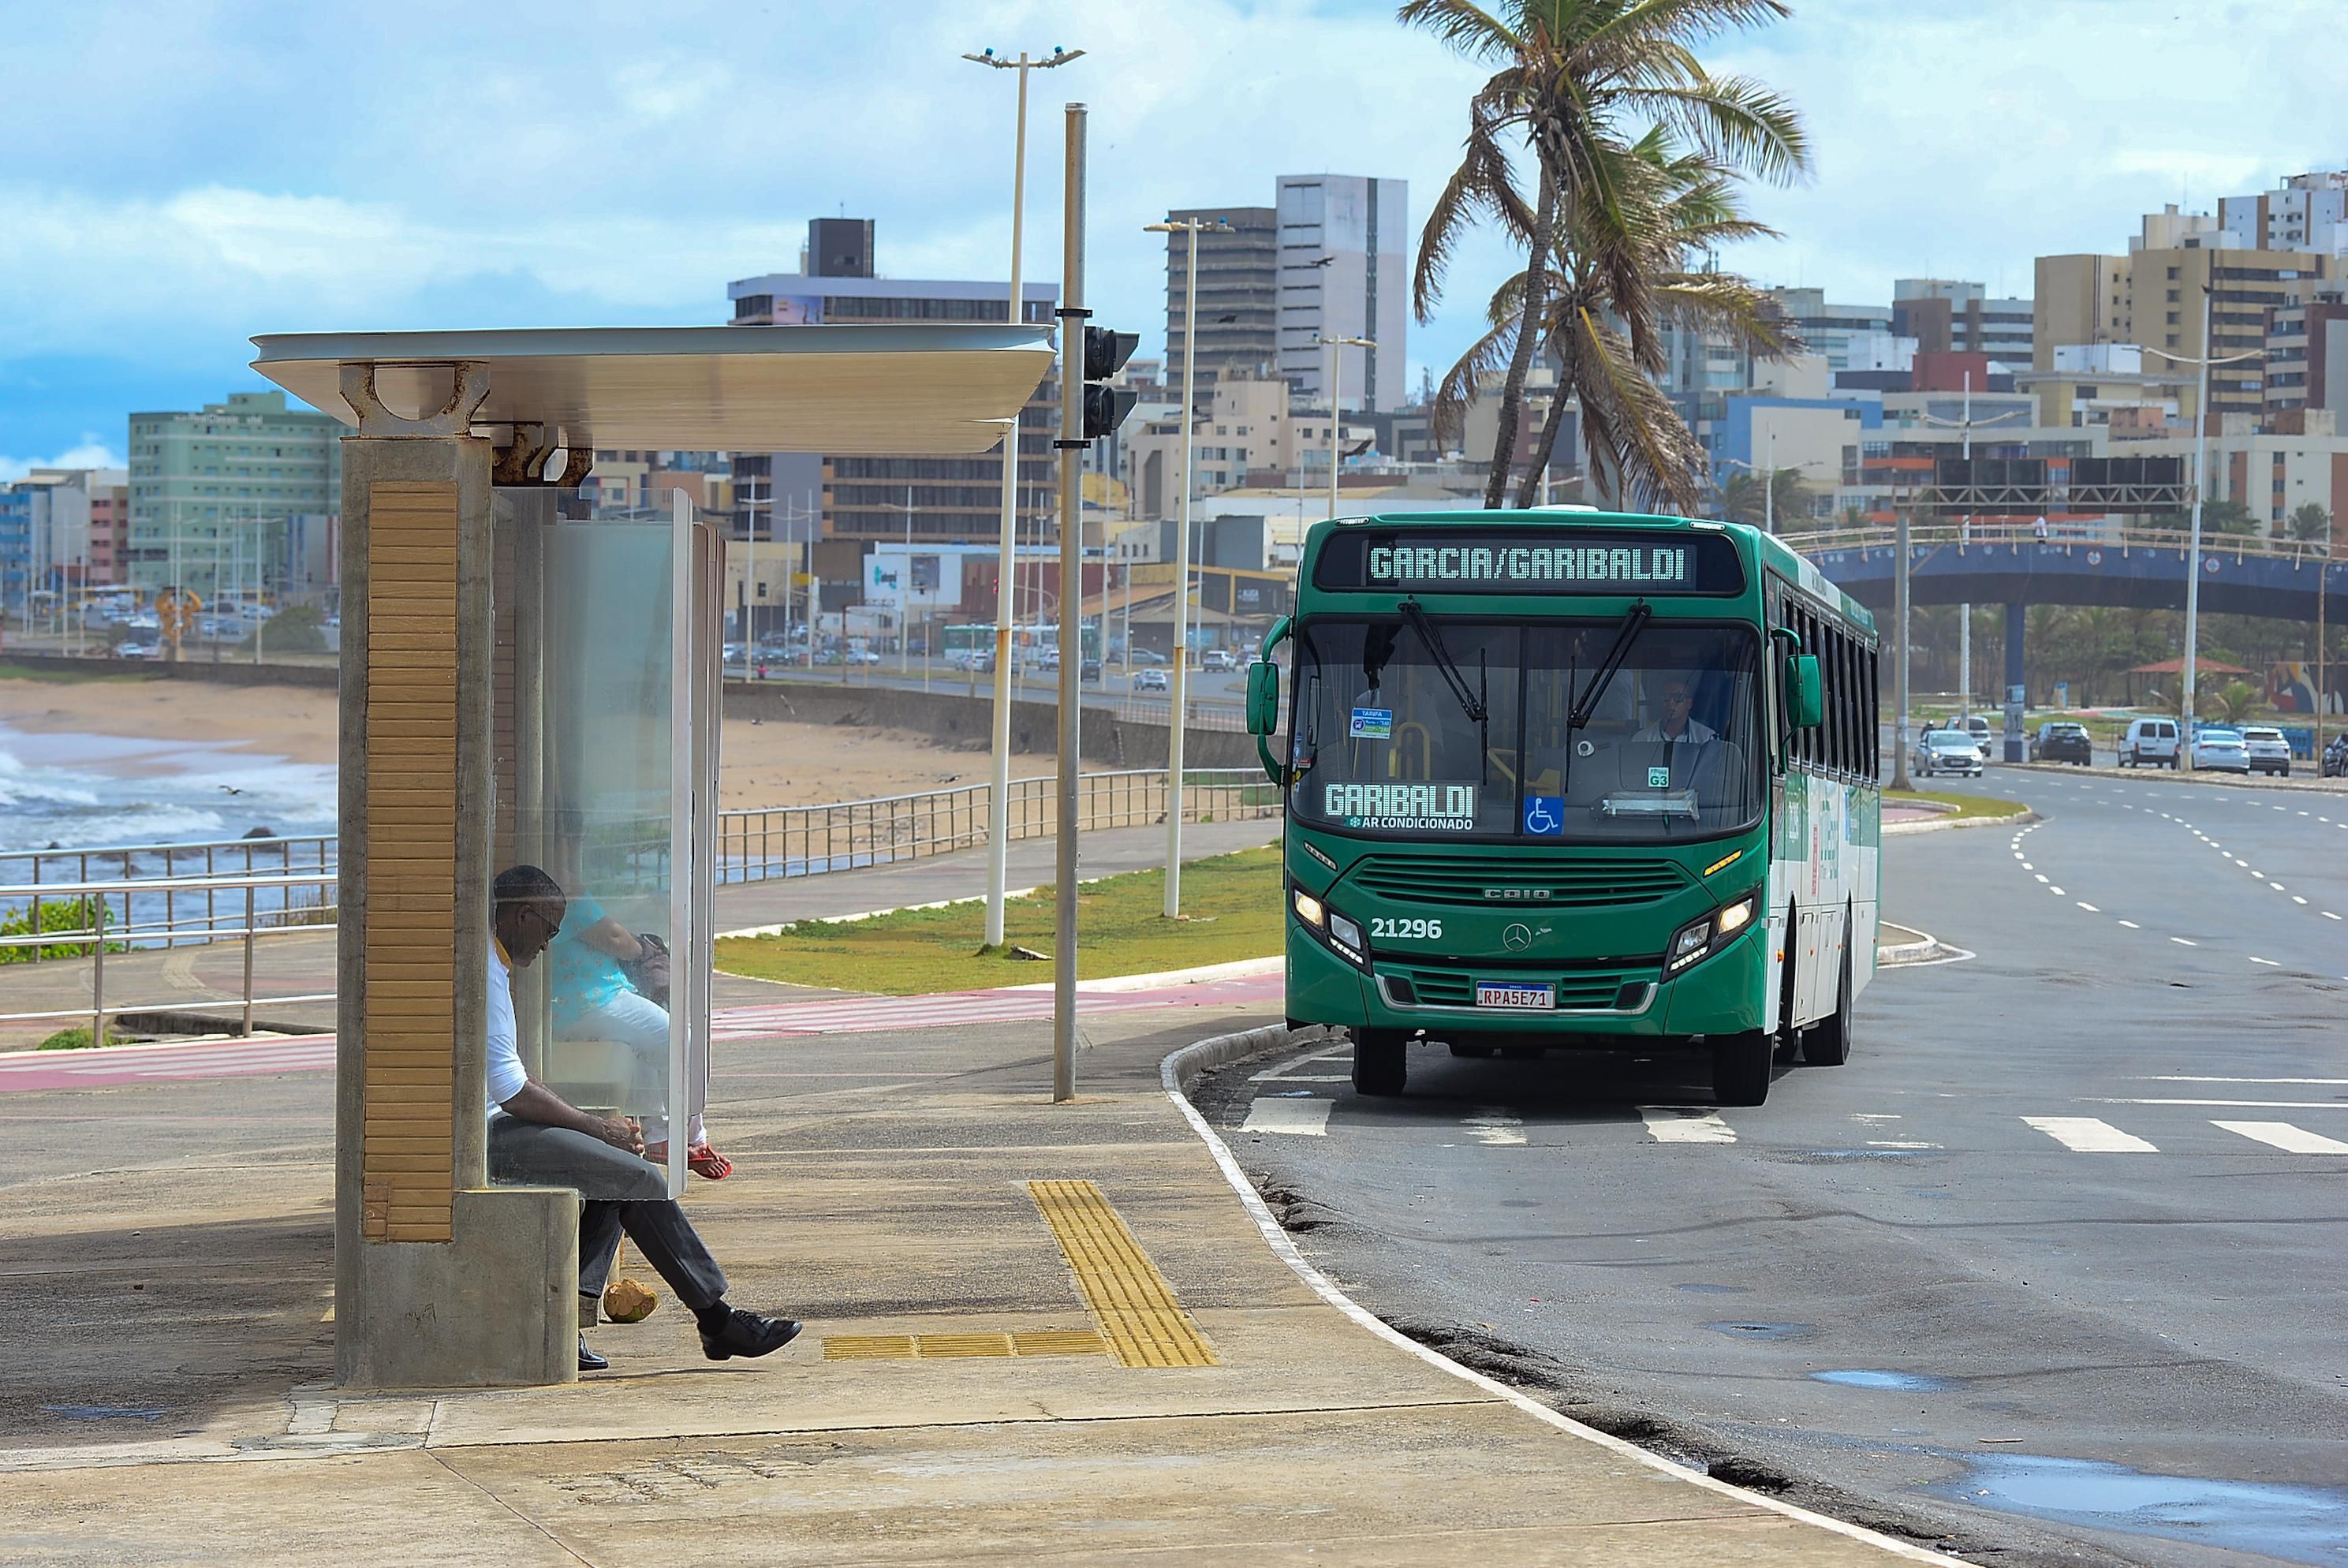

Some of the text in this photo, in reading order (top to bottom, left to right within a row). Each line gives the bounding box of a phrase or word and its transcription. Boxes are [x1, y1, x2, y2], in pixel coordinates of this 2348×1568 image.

[1371, 547, 1685, 581] GARCIA/GARIBALDI
[1650, 775, 1667, 786] G3
[1325, 784, 1473, 818] GARIBALDI
[1362, 817, 1473, 831] AR CONDICIONADO
[1484, 889, 1550, 899] CAIO
[1371, 917, 1442, 939] 21296
[1484, 990, 1547, 1006] RPA5E71
